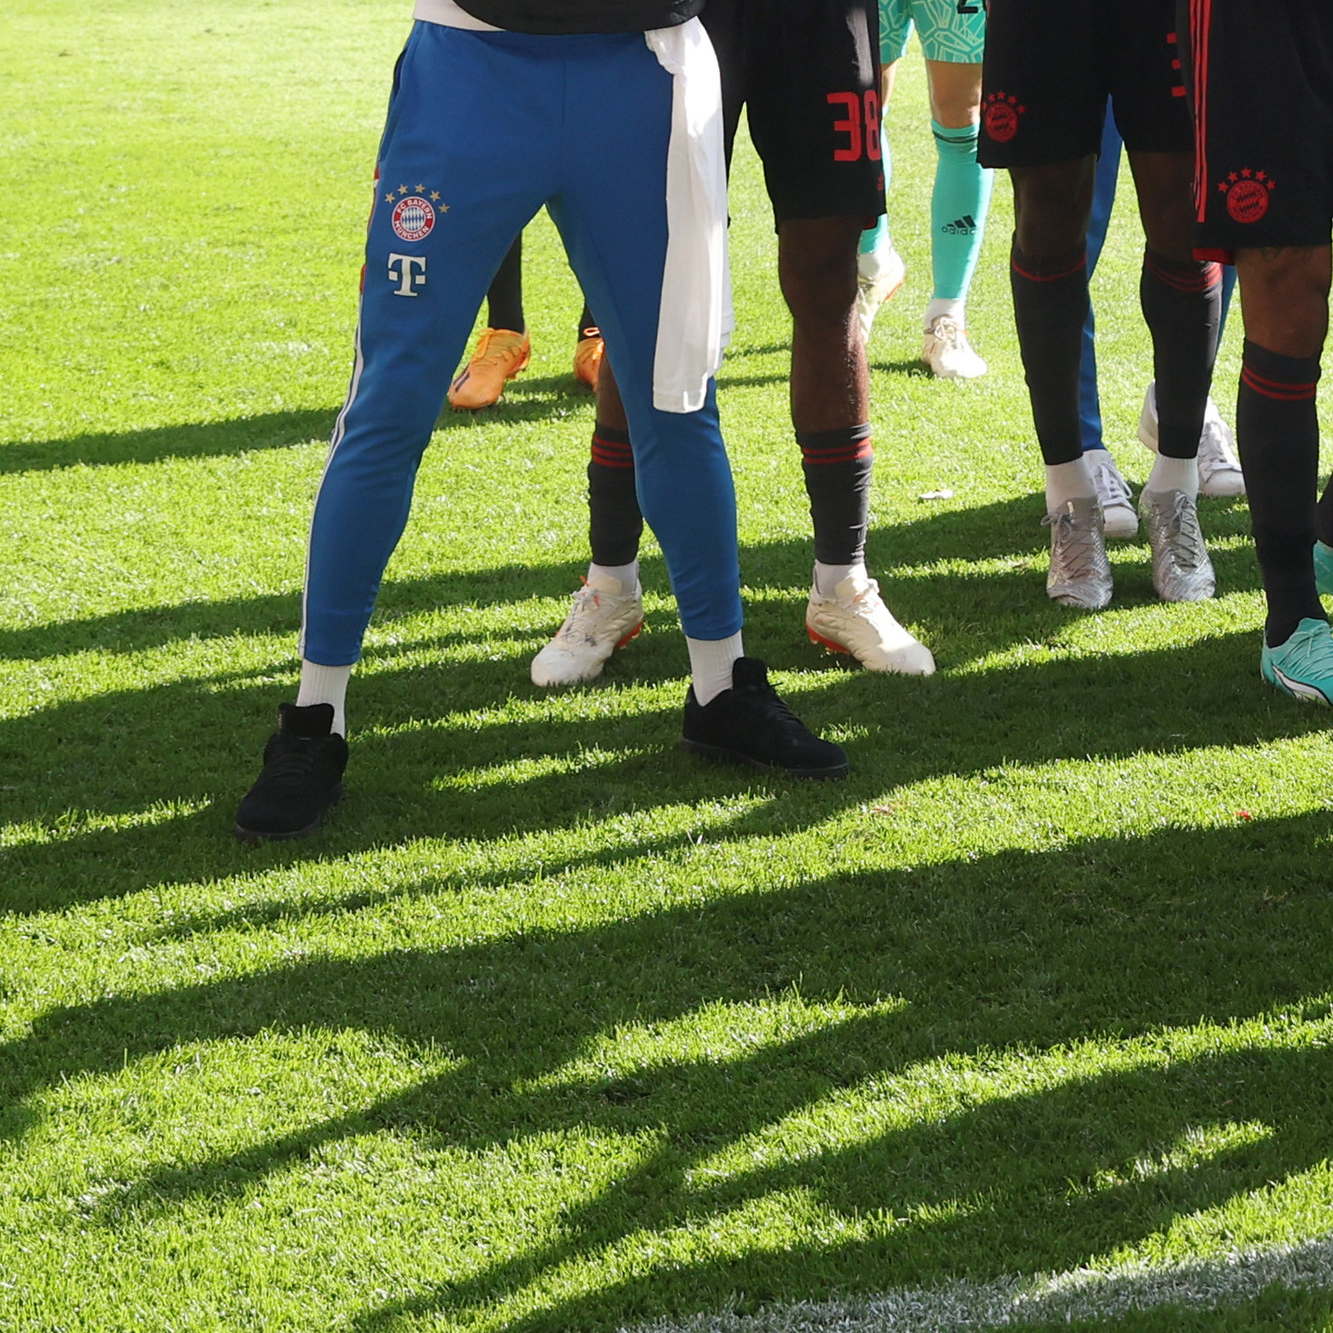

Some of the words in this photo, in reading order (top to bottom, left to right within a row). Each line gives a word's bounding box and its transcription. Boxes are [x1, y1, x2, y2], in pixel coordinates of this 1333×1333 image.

[826, 89, 881, 162] 38
[407, 198, 433, 220] BAYERN
[394, 220, 429, 240] MÜNCHEN
